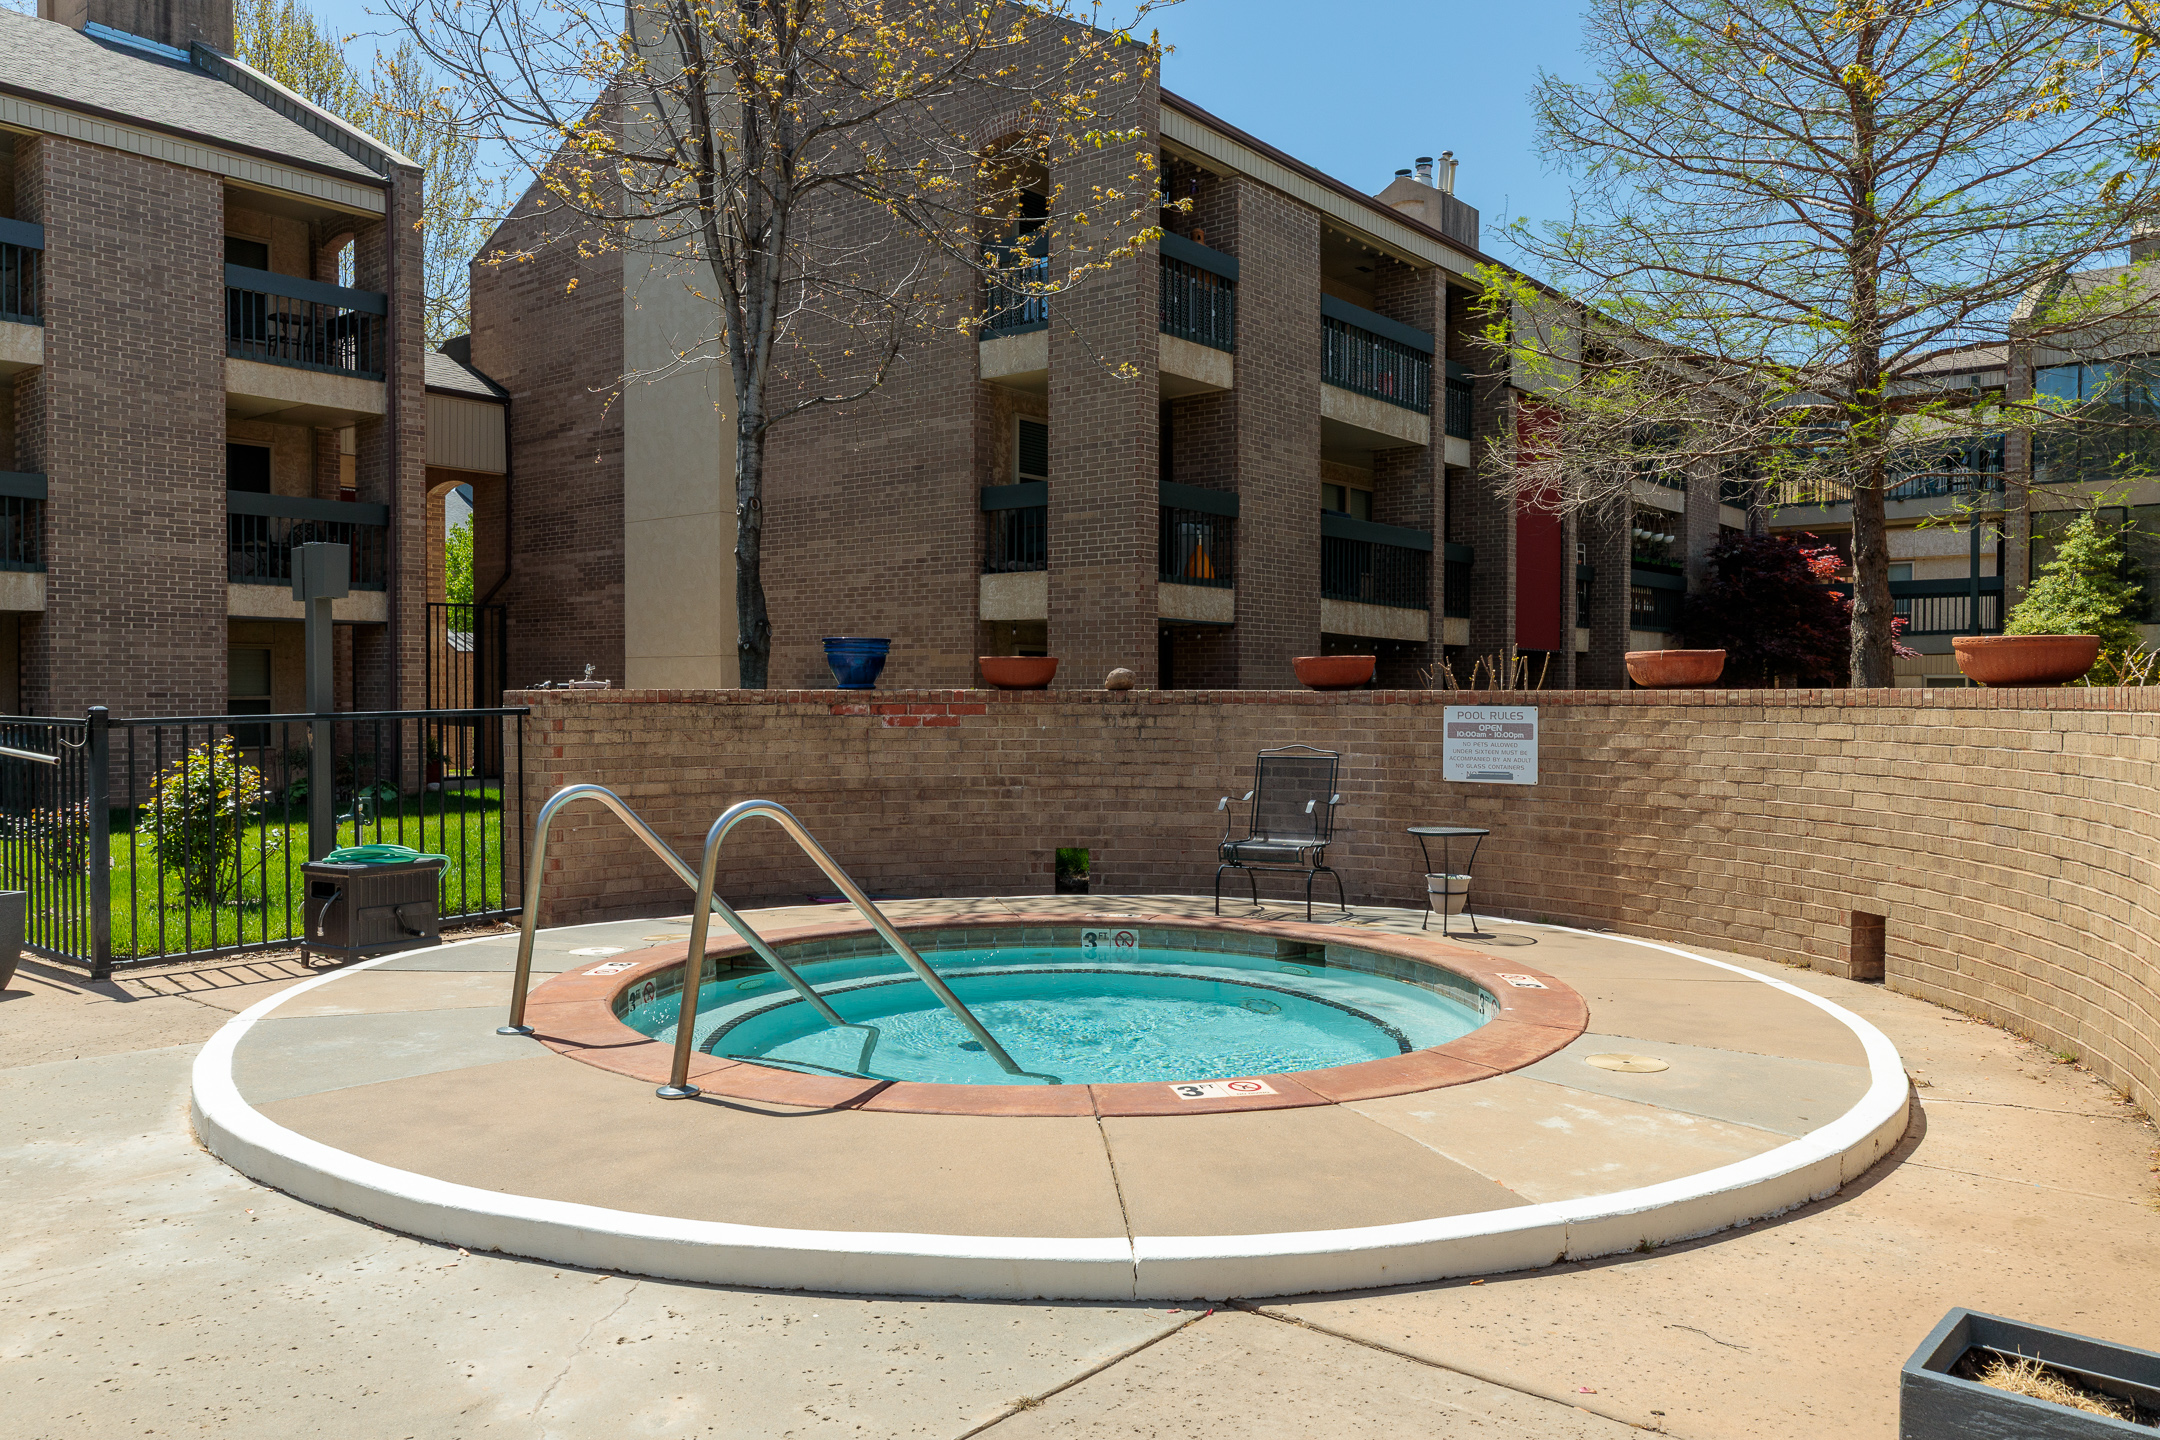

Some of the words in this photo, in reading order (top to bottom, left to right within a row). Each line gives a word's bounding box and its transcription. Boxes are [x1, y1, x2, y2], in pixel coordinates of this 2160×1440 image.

[1457, 711, 1485, 720] POOL
[1490, 711, 1524, 720] RULES
[1478, 724, 1503, 732] OPEN
[1494, 731, 1524, 739] 10:00pm
[1084, 932, 1097, 947] 3
[629, 992, 636, 1012] 3
[1479, 993, 1484, 1015] 3
[1177, 1086, 1204, 1097] 3
